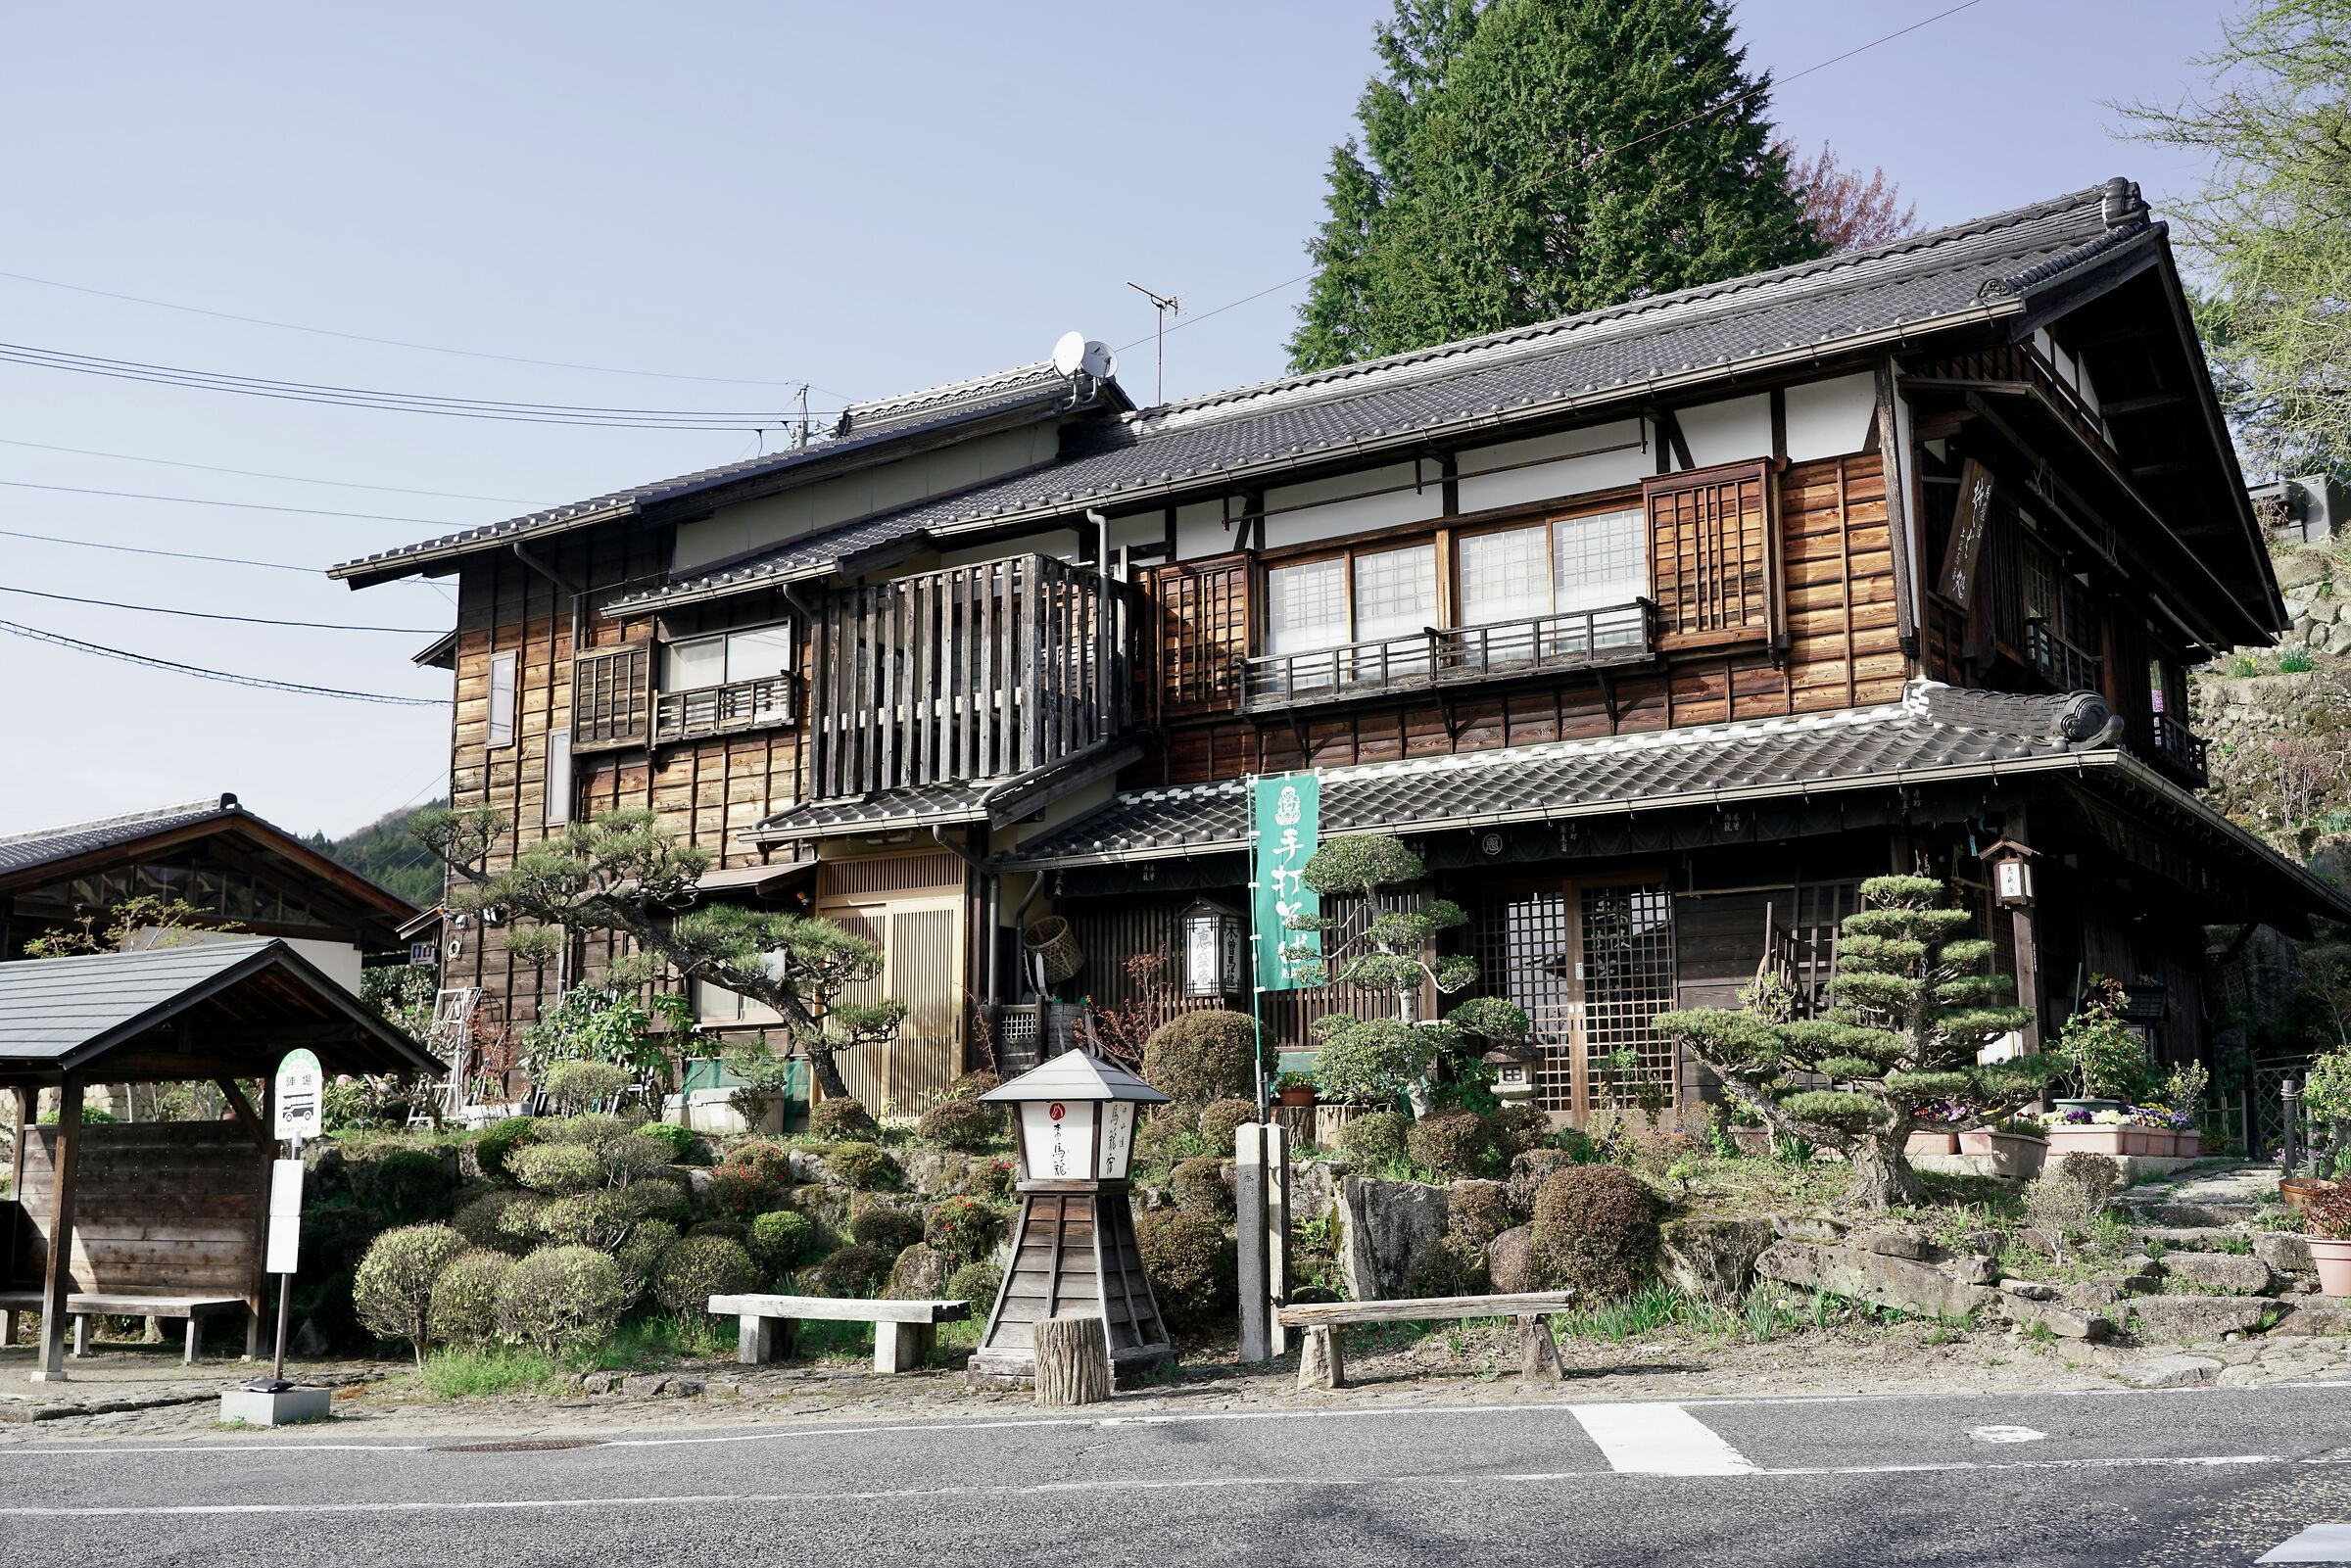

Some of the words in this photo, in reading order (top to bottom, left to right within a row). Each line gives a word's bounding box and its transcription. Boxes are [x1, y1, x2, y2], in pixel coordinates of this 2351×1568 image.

[1195, 927, 1213, 985] 恵盛庵
[1106, 1104, 1119, 1175] 馬籠宿
